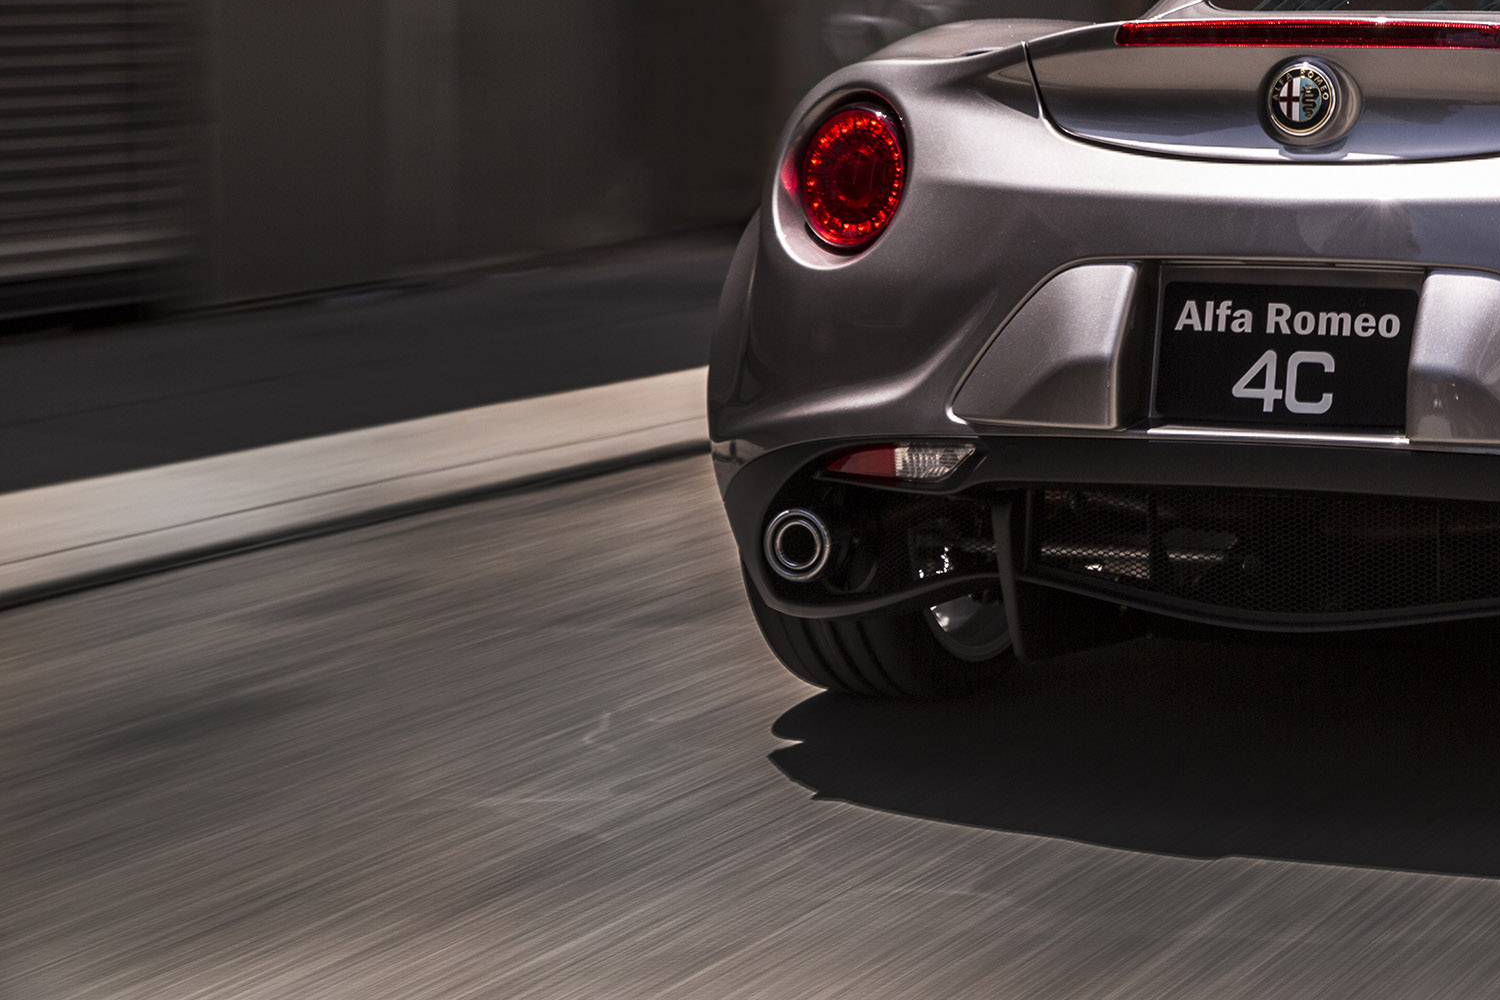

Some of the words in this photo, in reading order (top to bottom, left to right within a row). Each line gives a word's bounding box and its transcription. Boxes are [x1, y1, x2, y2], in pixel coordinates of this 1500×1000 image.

[1272, 72, 1293, 100] ALFA
[1300, 69, 1329, 100] ROMEO
[1174, 300, 1253, 333] Alfa
[1265, 302, 1401, 339] Romeo
[1231, 349, 1336, 415] 4C
